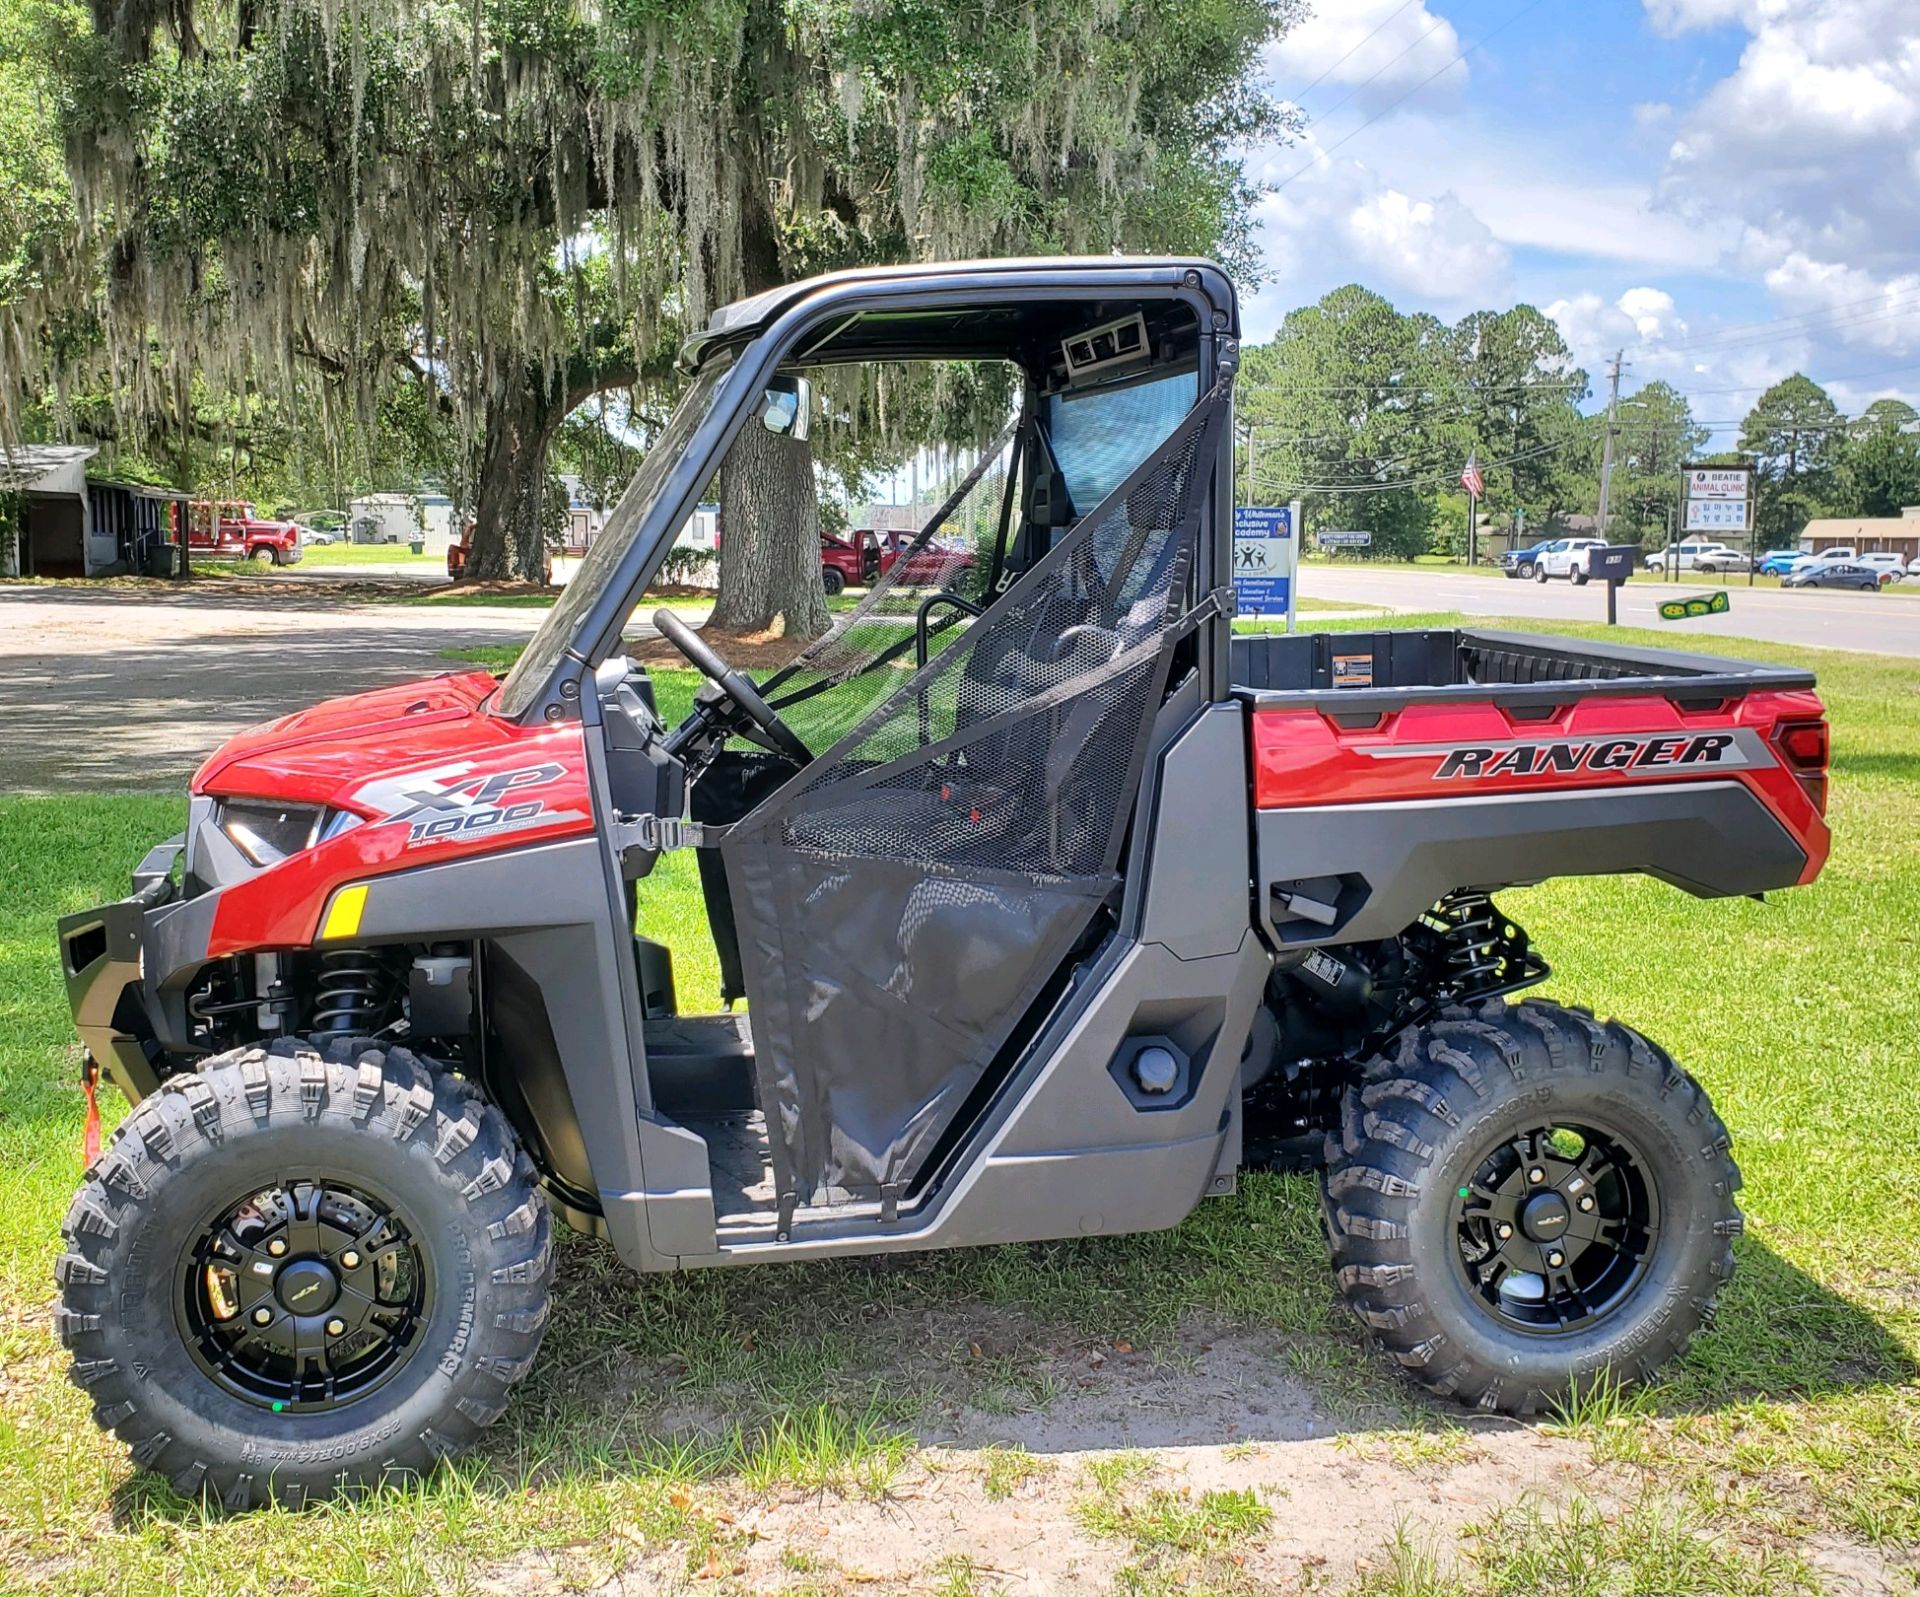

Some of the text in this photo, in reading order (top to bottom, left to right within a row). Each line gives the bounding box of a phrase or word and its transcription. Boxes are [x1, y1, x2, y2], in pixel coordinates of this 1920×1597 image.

[1692, 483, 1745, 491] ANIMAL CLINIC
[1432, 735, 1735, 780] RANGER
[367, 761, 568, 829] XP
[407, 801, 544, 842] 1000
[408, 819, 537, 849] DUAL OVERHEAD CAM
